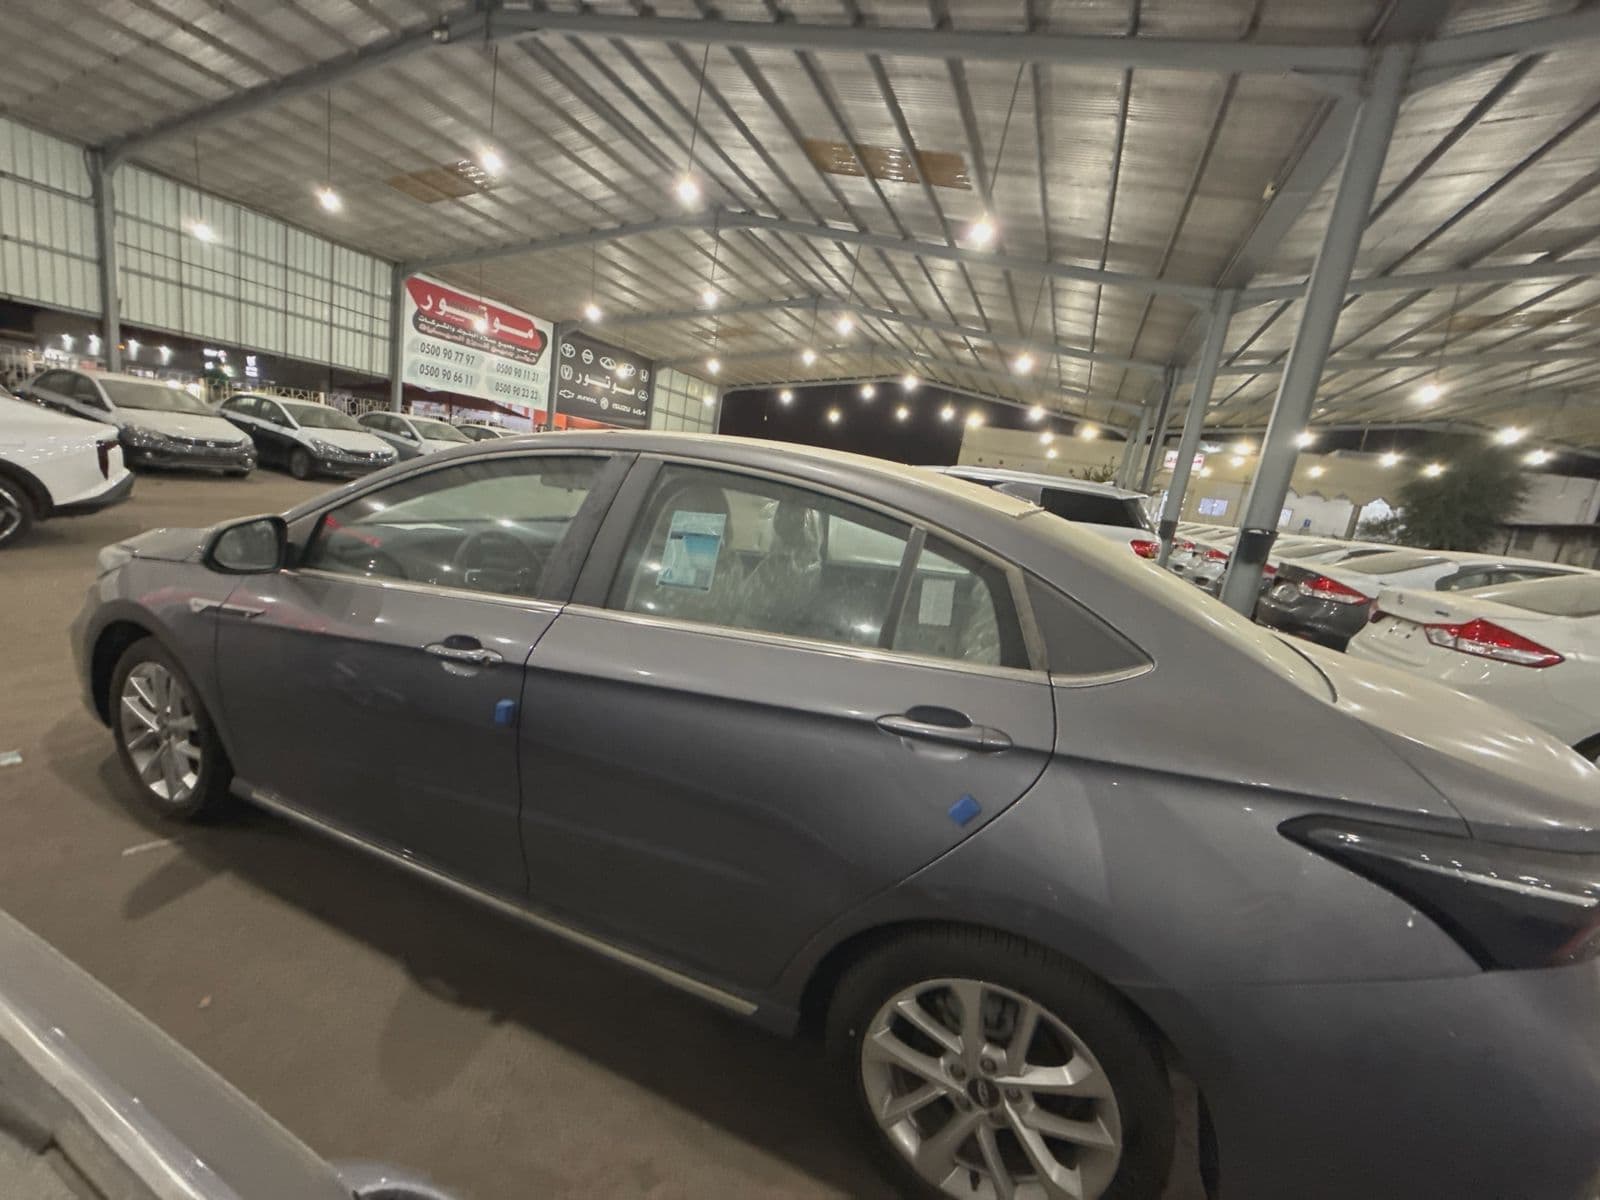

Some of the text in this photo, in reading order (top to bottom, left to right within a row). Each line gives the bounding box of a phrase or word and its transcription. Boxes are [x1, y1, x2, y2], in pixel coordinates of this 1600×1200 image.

[420, 342, 475, 366] 0500 90 77 97
[419, 363, 473, 386] 0500 90 66 11
